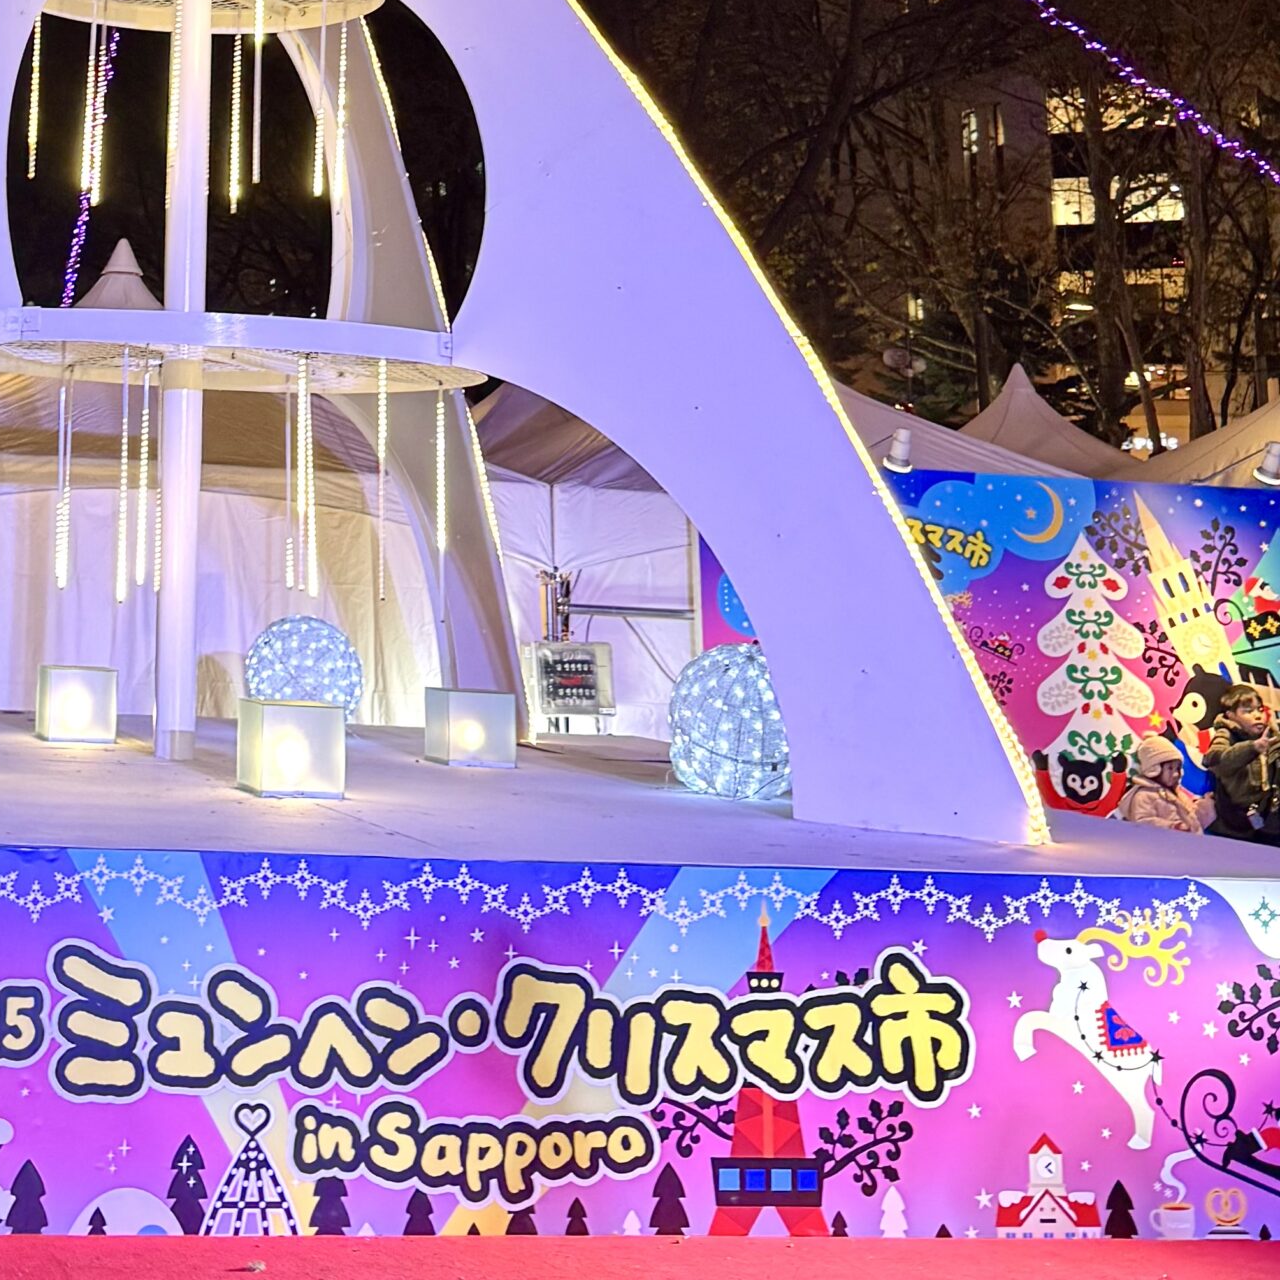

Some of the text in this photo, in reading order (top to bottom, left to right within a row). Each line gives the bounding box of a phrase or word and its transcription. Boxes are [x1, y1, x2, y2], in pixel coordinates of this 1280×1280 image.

[56, 955, 967, 1100] ミュンヘン・クリスマス市
[300, 1108, 649, 1197] in Sapporo
